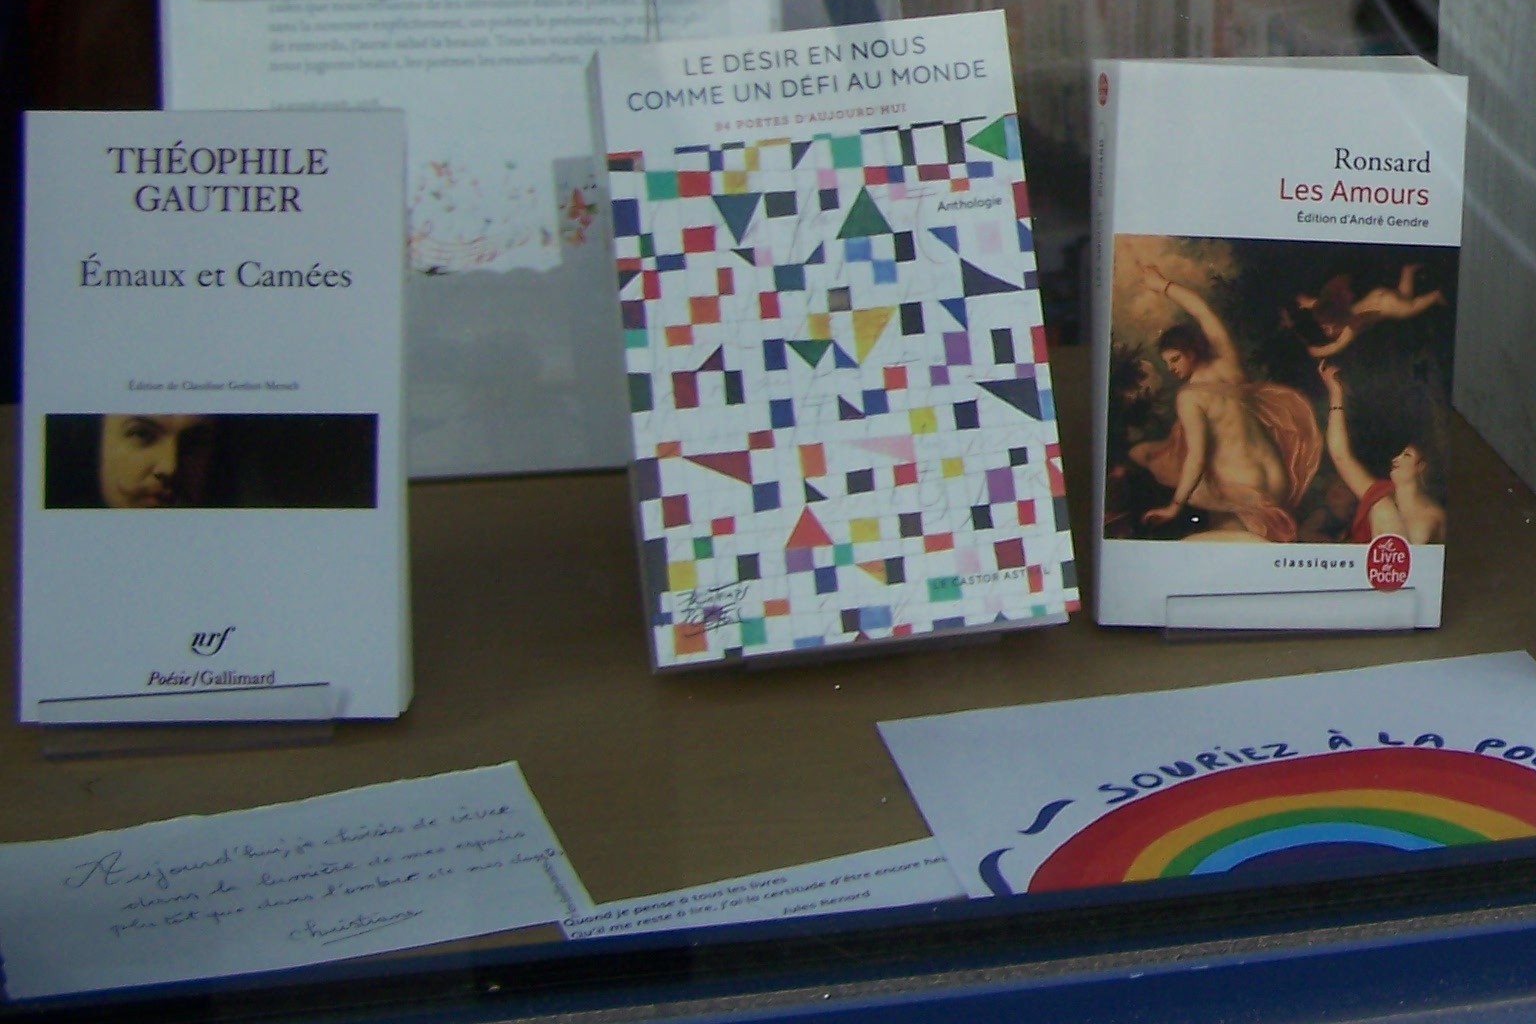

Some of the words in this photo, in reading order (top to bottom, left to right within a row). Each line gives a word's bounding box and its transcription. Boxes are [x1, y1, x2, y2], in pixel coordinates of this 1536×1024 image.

[683, 54, 714, 77] LE
[723, 48, 799, 74] DÉSIR
[809, 43, 842, 65] EN
[851, 35, 927, 62] NOUS
[626, 85, 726, 113] COMME
[734, 78, 772, 103] UN
[781, 73, 839, 98] DÉFI
[846, 70, 882, 93] AU
[891, 58, 988, 89] MONDE
[107, 140, 329, 176] THÉOPHILE
[1335, 148, 1431, 173] Ronsard
[135, 184, 302, 213] GAUTIER
[1280, 178, 1323, 202] Les
[1331, 180, 1429, 206] Amours
[937, 195, 1002, 214] Anthologie
[1297, 211, 1337, 225] Édition
[1387, 216, 1429, 228] Gendre
[79, 252, 187, 288] Émaux
[197, 267, 225, 288] et
[237, 260, 353, 288] Camées
[1274, 557, 1355, 571] classiques
[1373, 549, 1405, 563] Livre
[952, 573, 999, 586] CASTOR
[1370, 569, 1407, 582] Poche
[191, 626, 237, 656] nrf
[146, 671, 275, 687] Poésie/Gallimard
[1377, 730, 1445, 749] LA
